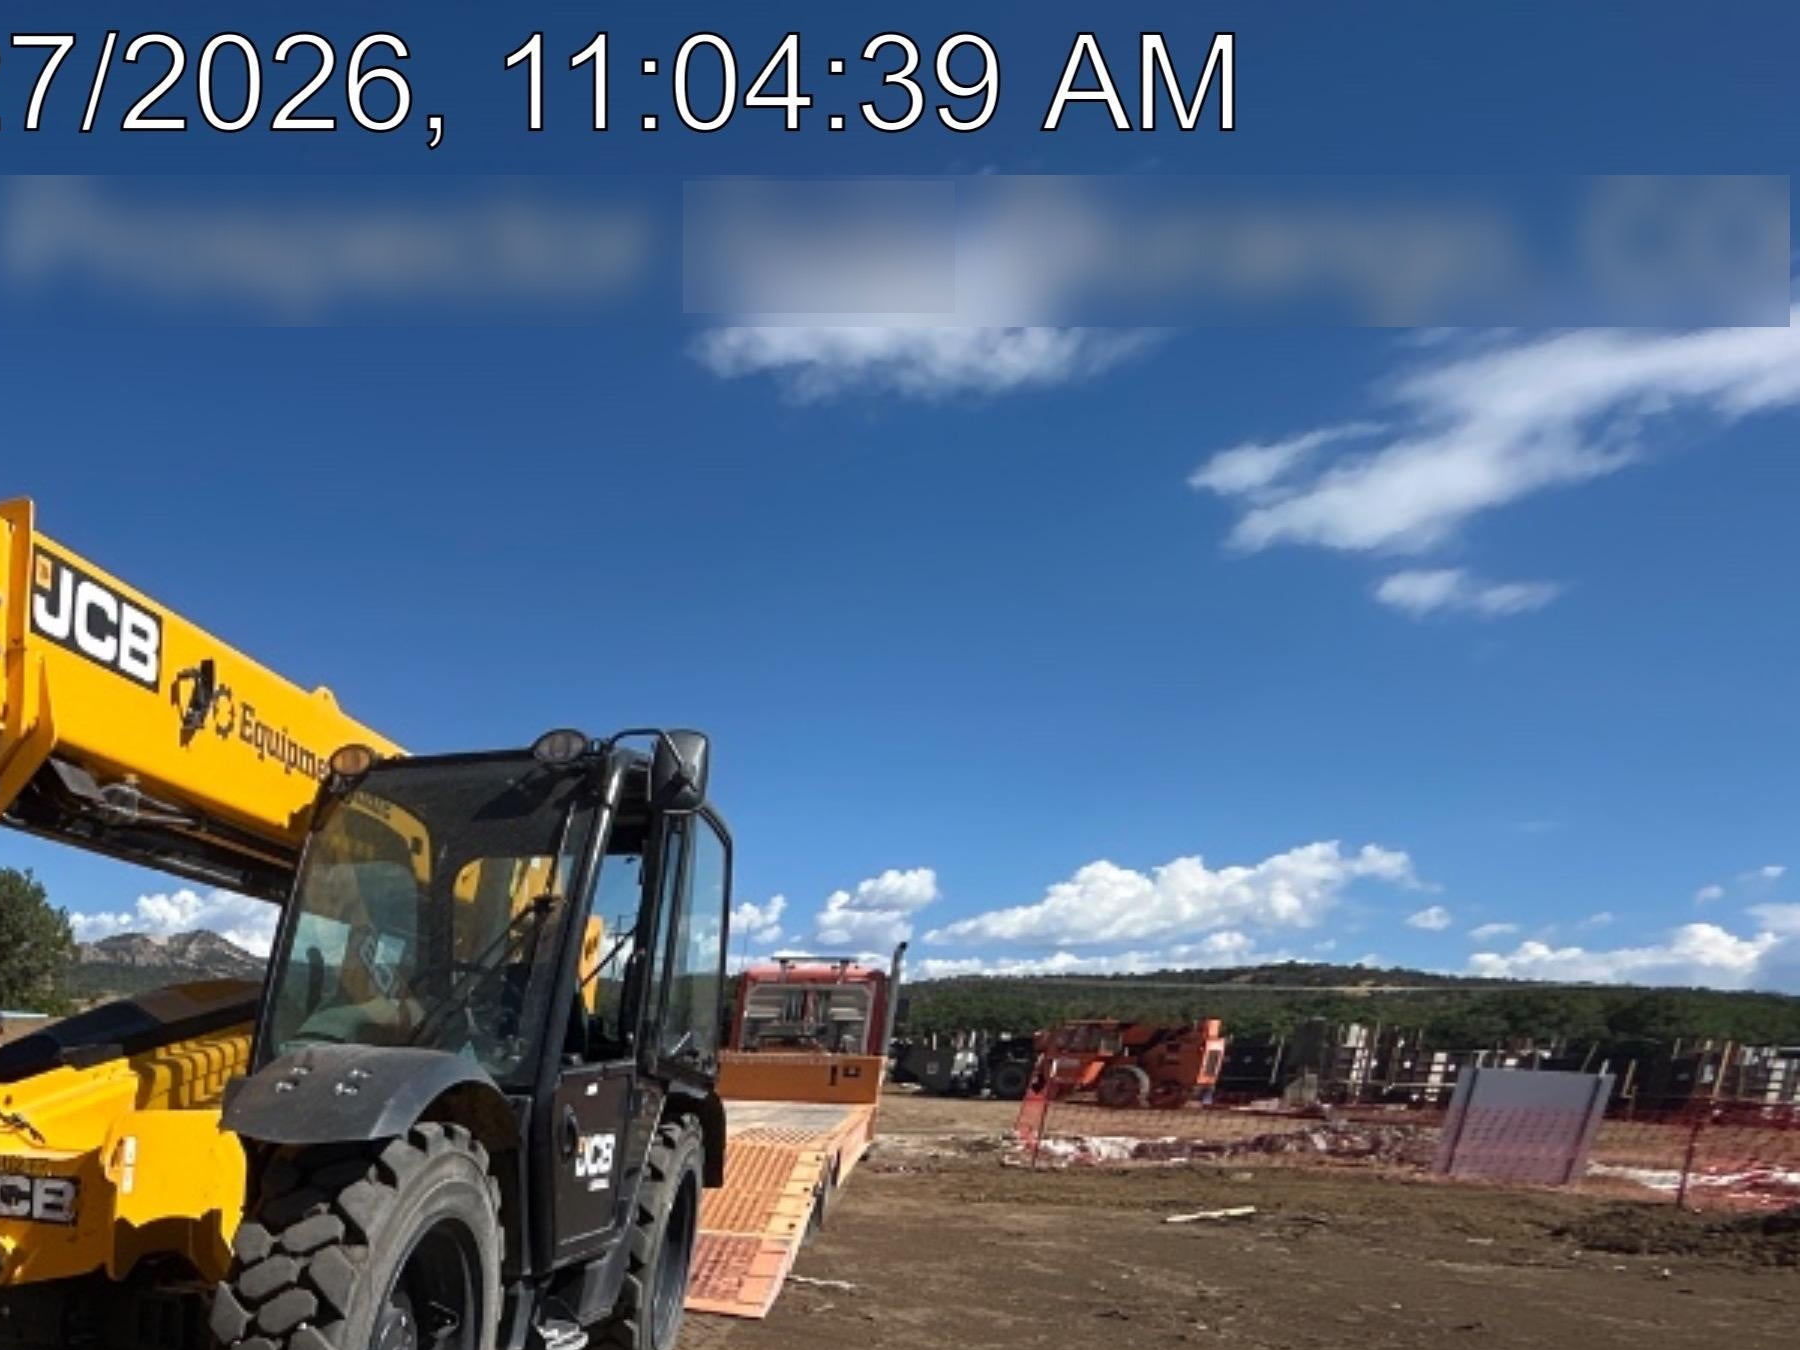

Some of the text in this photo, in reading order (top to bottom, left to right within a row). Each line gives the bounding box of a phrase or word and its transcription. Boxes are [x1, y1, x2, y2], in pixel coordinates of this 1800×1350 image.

[32, 565, 160, 683] JCB
[240, 701, 331, 781] Equipme
[575, 1132, 616, 1177] JCB
